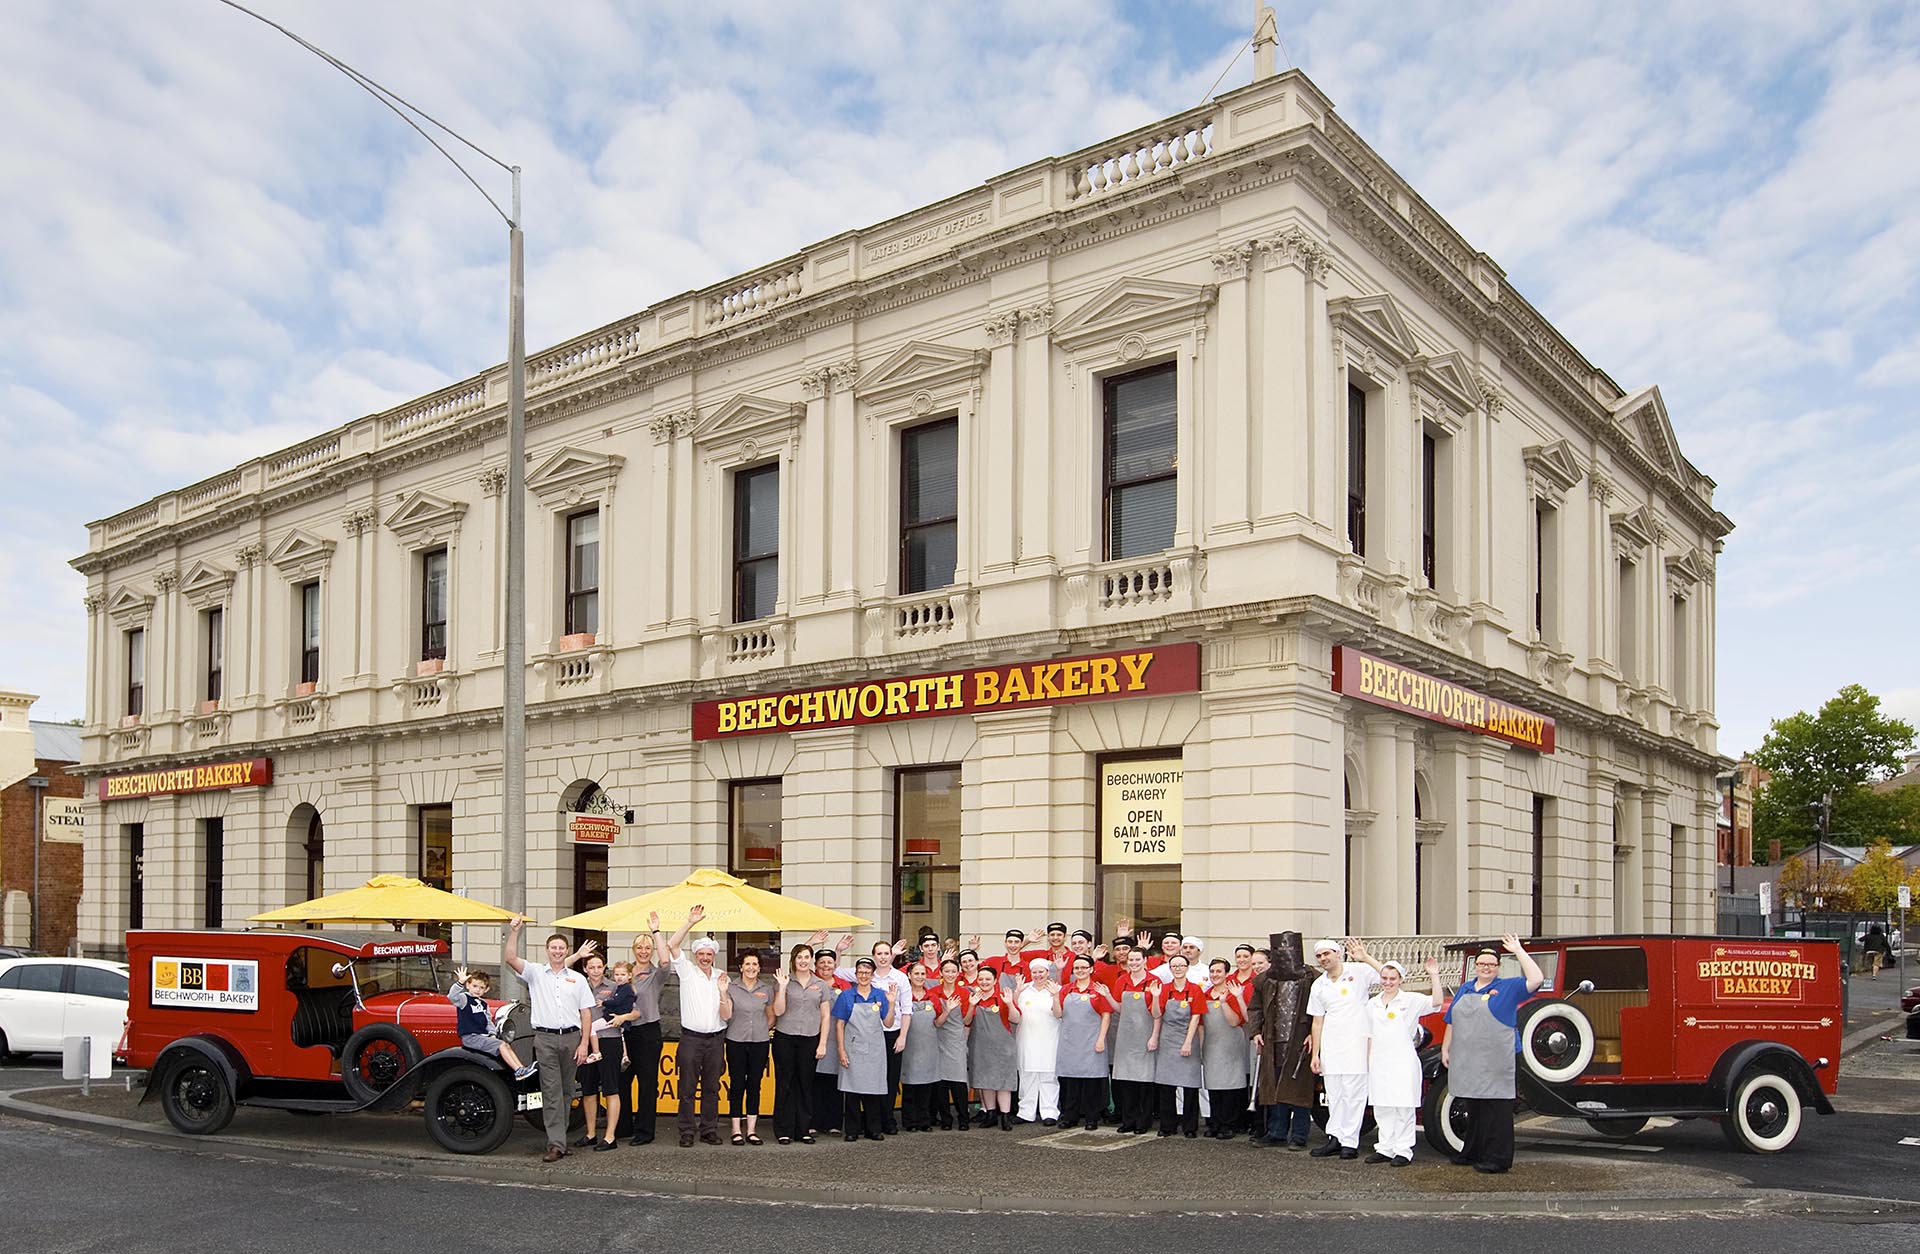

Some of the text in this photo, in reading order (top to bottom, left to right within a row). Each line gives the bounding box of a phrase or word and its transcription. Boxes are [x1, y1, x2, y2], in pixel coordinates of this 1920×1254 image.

[869, 241, 899, 262] WATER
[902, 226, 941, 250] SUPPLY
[717, 652, 1155, 733] BEECHWORTH BAKERY
[1359, 656, 1545, 745] BEECHWORTH BAKERY
[107, 761, 253, 797] BEECHWORTH BAKERY
[1127, 810, 1162, 823] OPEN
[570, 822, 620, 834] BEECHWORTH
[580, 831, 610, 839] BAKERY
[1114, 826, 1139, 838] 6AM
[1150, 825, 1176, 837] 6PM
[1123, 840, 1166, 853] 7 DAYS
[373, 944, 438, 955] BEECHWORTH BAKERY
[182, 967, 203, 985] BB
[1699, 960, 1816, 980] BEECHWORTH
[1723, 978, 1792, 995] BAKERY
[155, 990, 255, 1003] BEECHWORTH BAKERY
